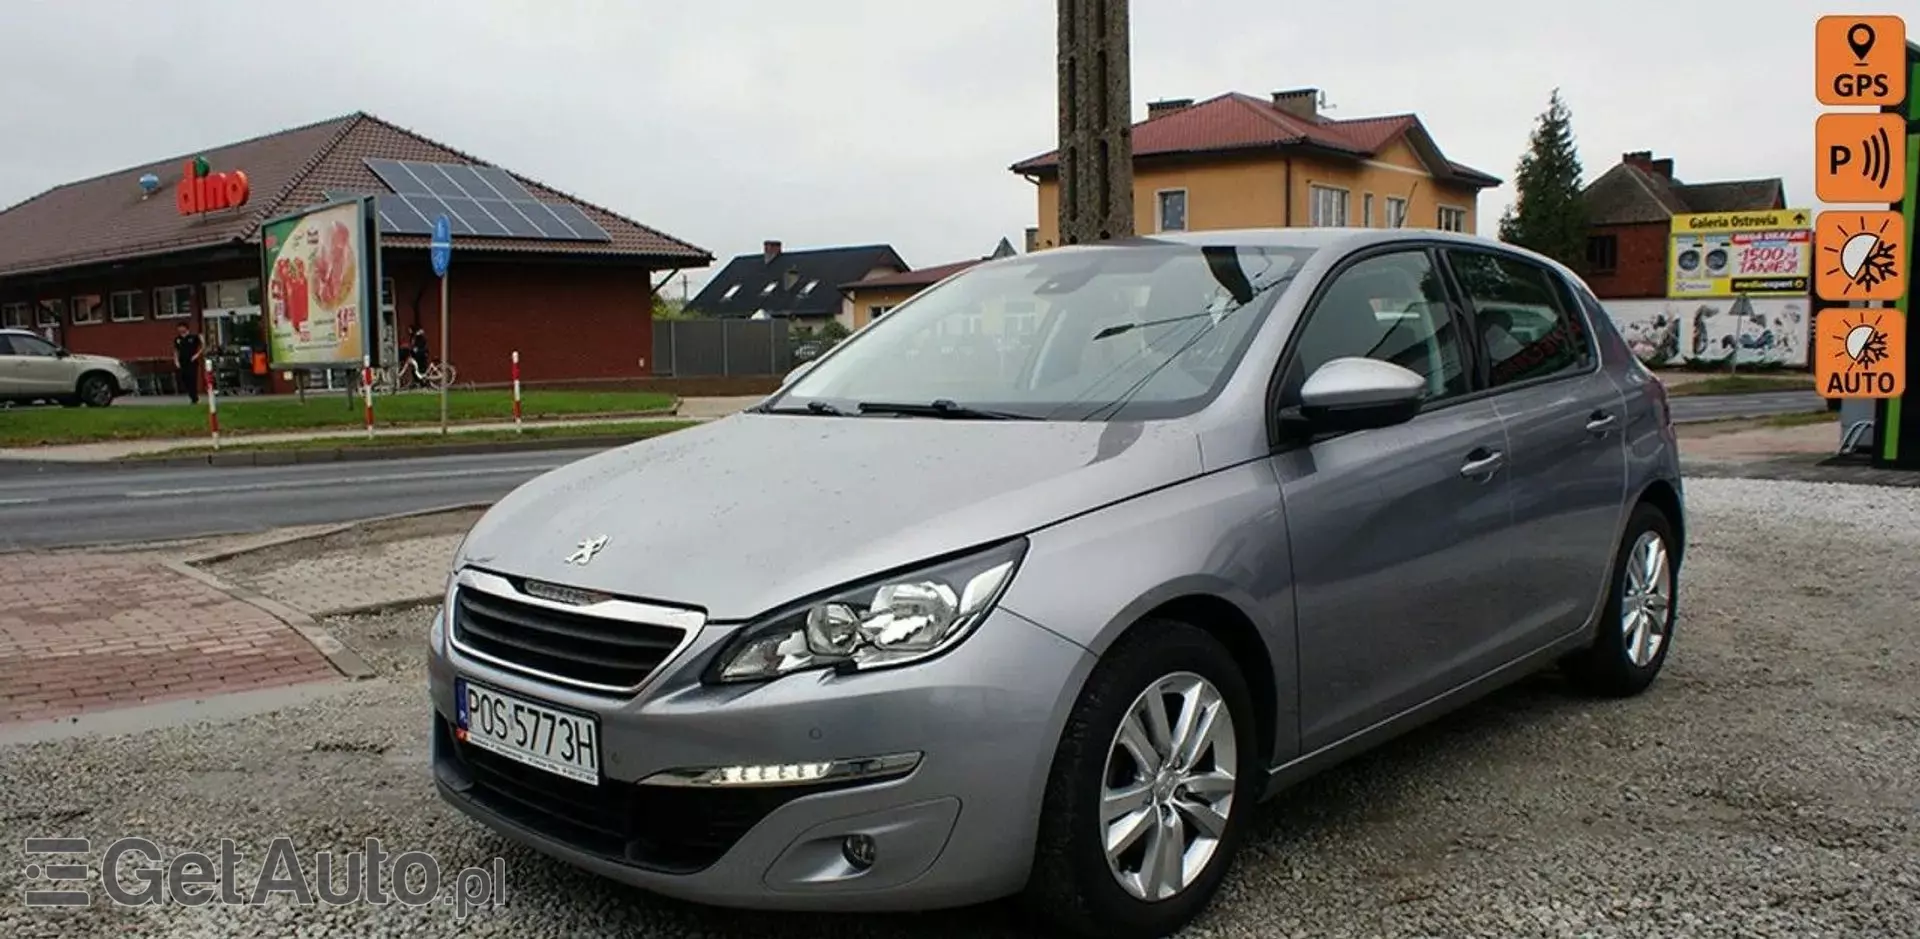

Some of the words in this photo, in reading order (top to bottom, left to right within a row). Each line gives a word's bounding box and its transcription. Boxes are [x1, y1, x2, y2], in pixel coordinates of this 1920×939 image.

[176, 160, 249, 216] dino
[1689, 217, 1729, 229] Galeria
[1731, 215, 1778, 228] Ostrovia
[468, 688, 508, 740] POS
[514, 704, 595, 768] 5773H
